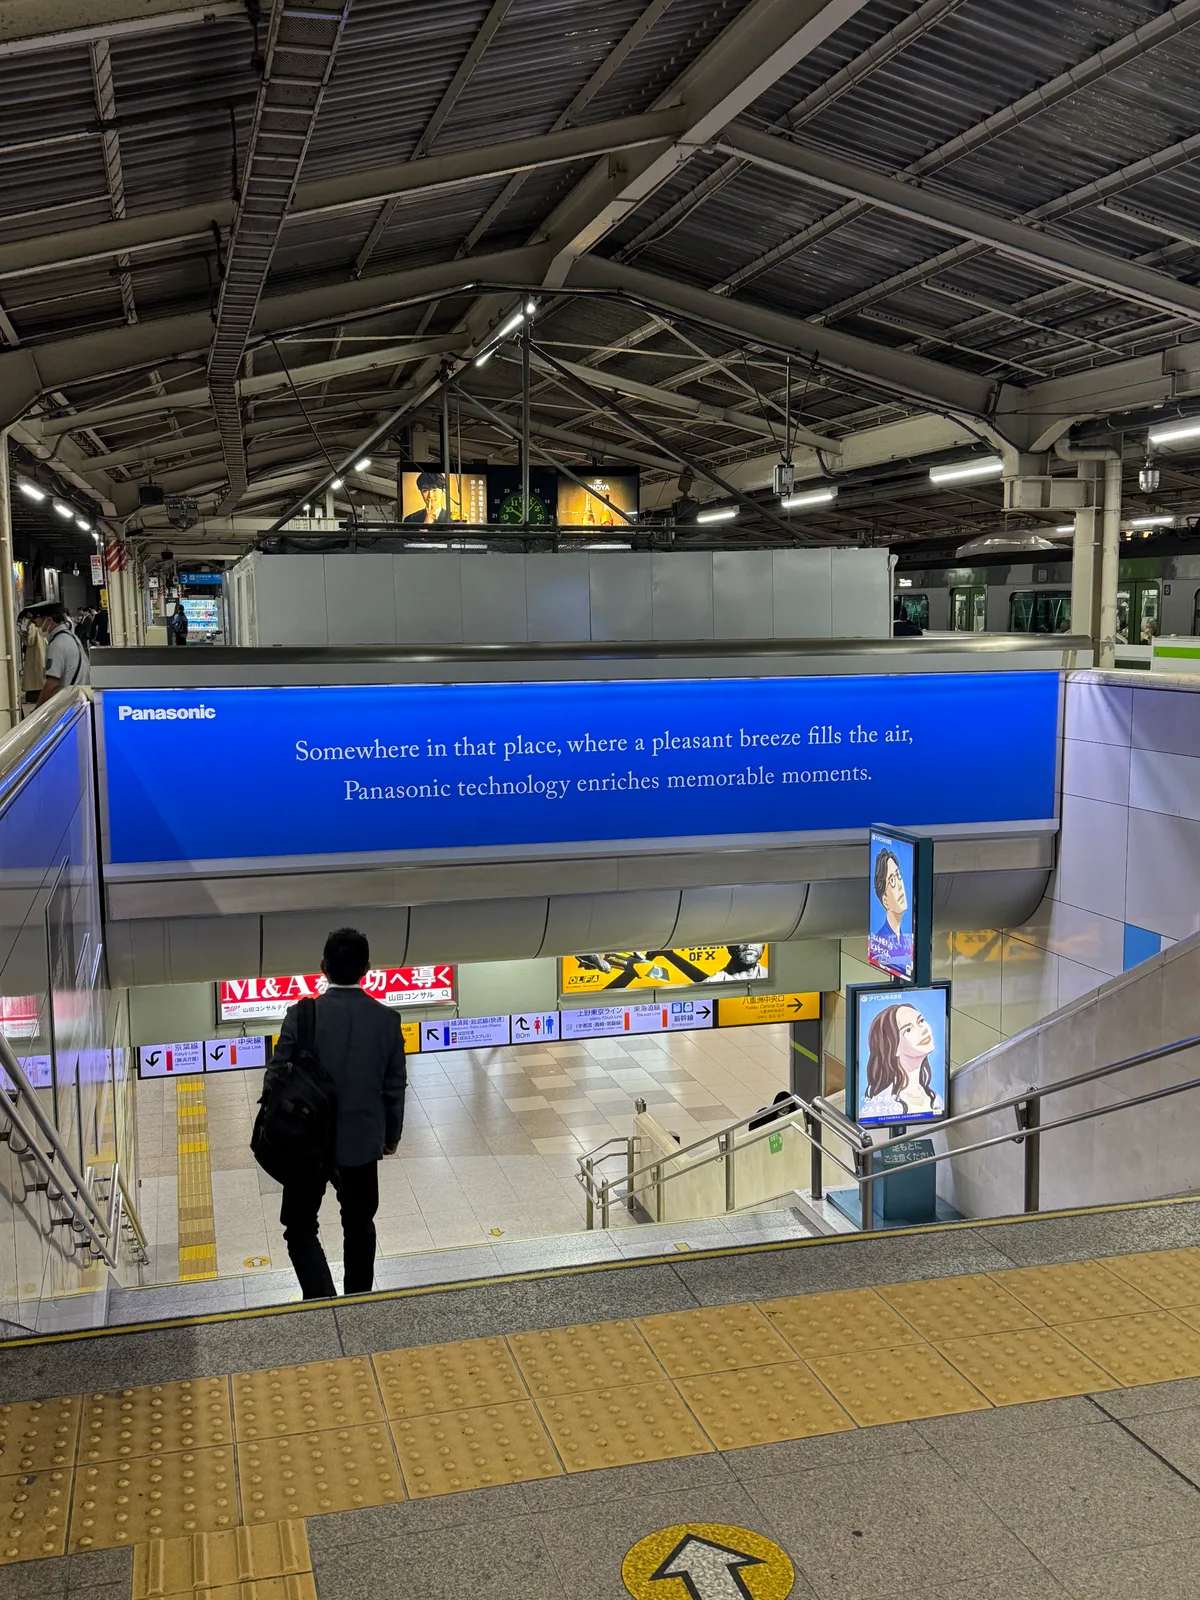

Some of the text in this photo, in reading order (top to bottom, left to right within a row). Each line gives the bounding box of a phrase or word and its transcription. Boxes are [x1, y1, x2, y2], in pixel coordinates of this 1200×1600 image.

[181, 574, 188, 584] 3
[1165, 585, 1170, 594] 6
[118, 704, 217, 721] Panasonic
[295, 724, 914, 762] Somewhere in that place, where a pleasant breeze fills the air,
[344, 765, 873, 801] Panasonic technology enriches memorable moments.
[689, 951, 716, 961] OF X
[223, 965, 452, 1002] M&Aを功へ導く
[569, 975, 599, 984] OLFA
[388, 991, 435, 1003] 山田コンサル
[577, 1007, 623, 1017] 上野東京ライン
[673, 1014, 695, 1022] 新幹線
[238, 1036, 261, 1046] 中央線
[174, 1042, 199, 1052] 京葉線
[891, 1141, 923, 1152] 足もとに
[884, 1151, 935, 1163] ご注意ください
